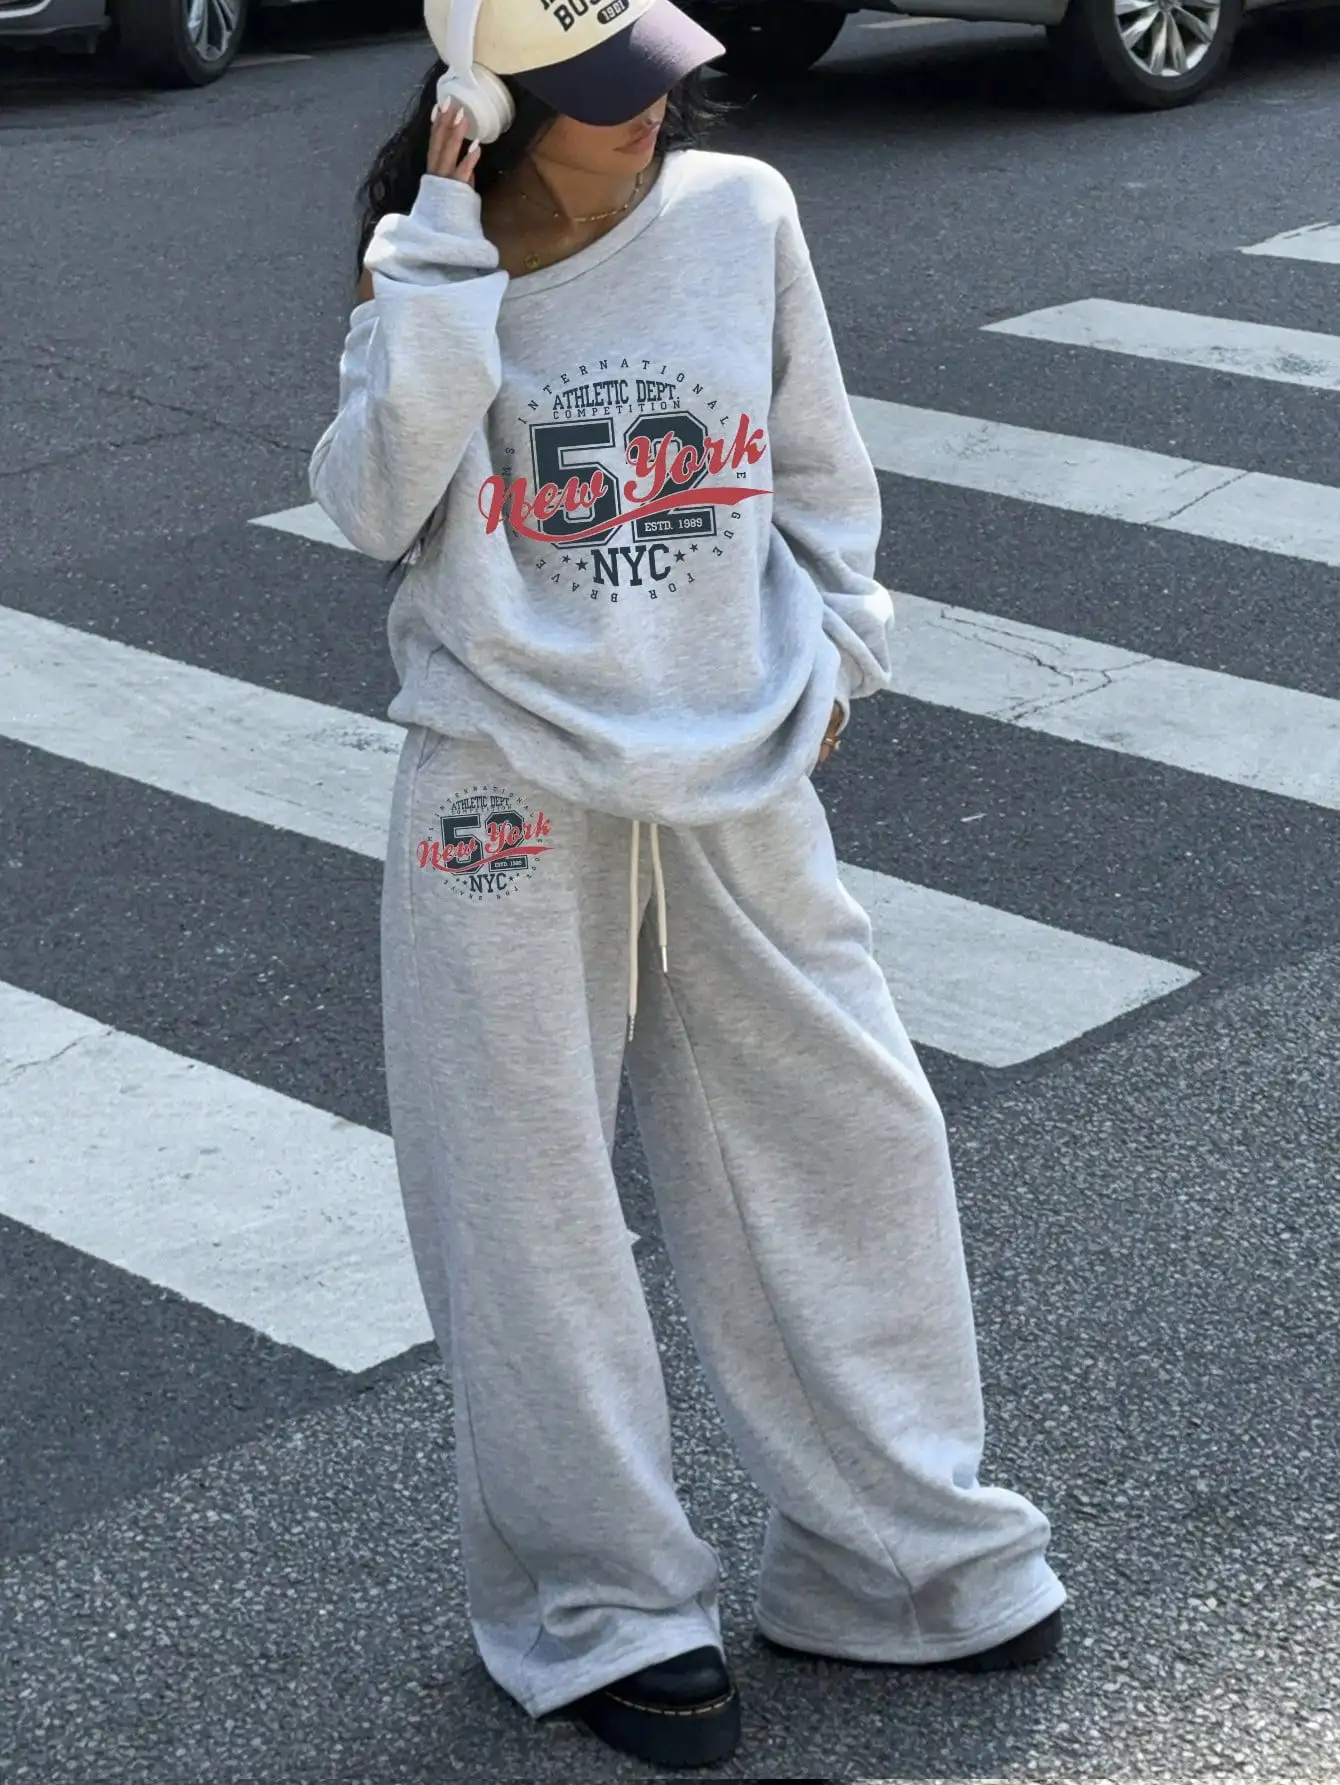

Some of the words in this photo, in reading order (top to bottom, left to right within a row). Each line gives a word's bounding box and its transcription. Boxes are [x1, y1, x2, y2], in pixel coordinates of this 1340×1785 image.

[517, 359, 729, 425] INTERNATIONAL
[553, 380, 629, 410] ATHLETIC
[636, 379, 680, 402] DEPT.
[553, 400, 681, 419] COMPETITION
[478, 471, 608, 534] New
[623, 413, 767, 503] York
[644, 521, 674, 532] ESTD.
[591, 544, 671, 587] NYC
[451, 796, 487, 811] ATHLETIC
[416, 838, 478, 868] New
[484, 811, 552, 854] York
[469, 873, 507, 893] NYC
